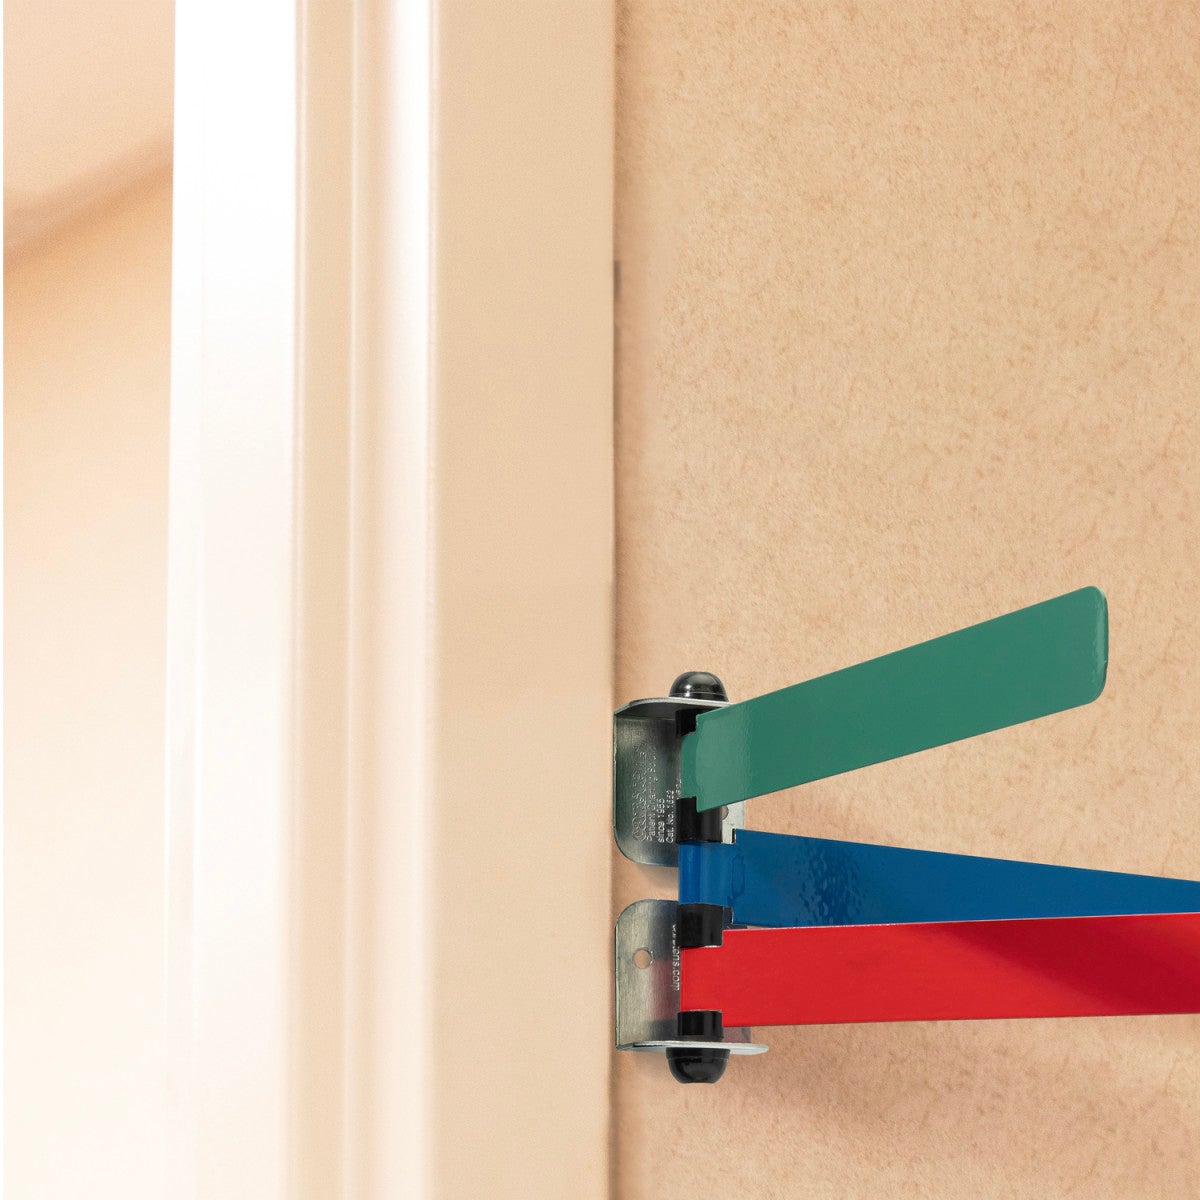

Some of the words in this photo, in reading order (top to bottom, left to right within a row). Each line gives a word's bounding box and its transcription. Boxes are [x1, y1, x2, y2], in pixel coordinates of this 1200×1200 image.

[665, 812, 674, 825] No.
[656, 820, 666, 843] since
[665, 827, 674, 844] Cat.
[672, 921, 681, 992] ens.com
